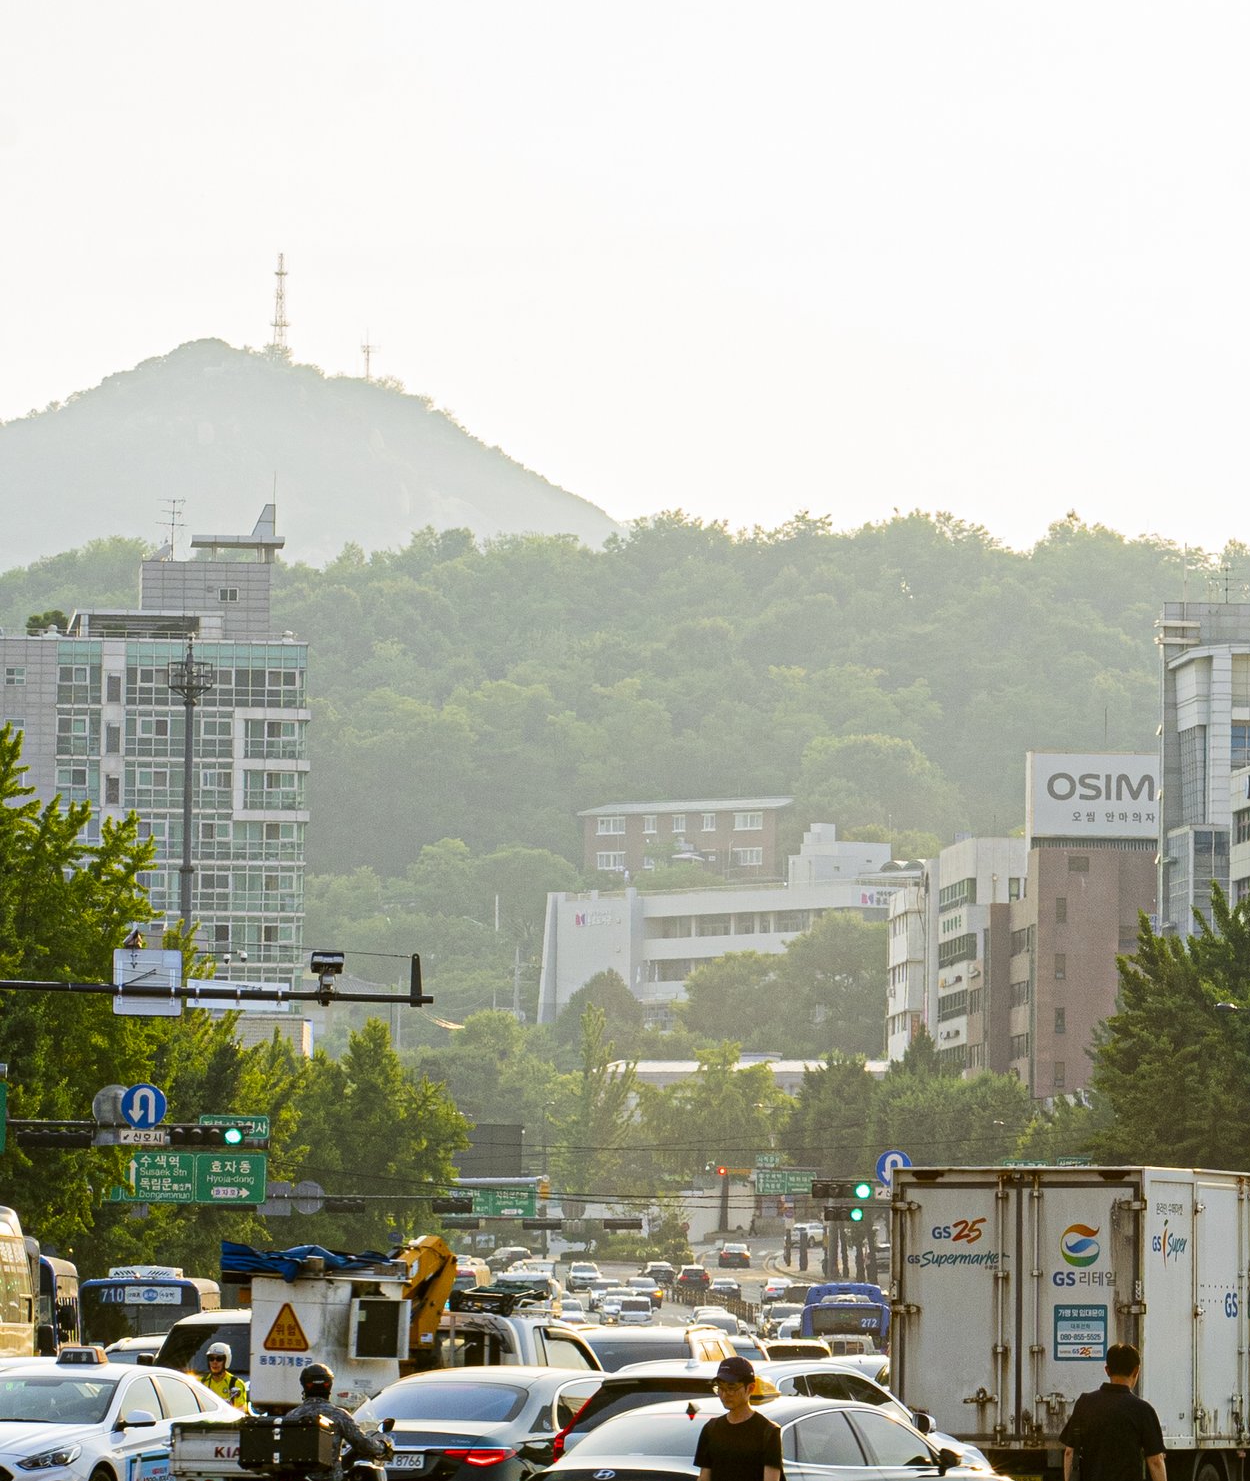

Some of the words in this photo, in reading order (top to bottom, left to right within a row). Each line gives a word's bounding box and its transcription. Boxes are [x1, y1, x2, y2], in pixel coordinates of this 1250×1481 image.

[1046, 772, 1155, 801] OSIM
[1105, 811, 1155, 823] 안마의자
[140, 1155, 179, 1168] 수색역
[210, 1160, 251, 1173] 효자동
[140, 1167, 171, 1176] Susaek
[1052, 1271, 1076, 1286] GS
[1079, 1271, 1117, 1287] 리테일
[101, 1288, 124, 1302] 710
[1224, 1292, 1238, 1318] GS
[861, 1318, 877, 1328] 272
